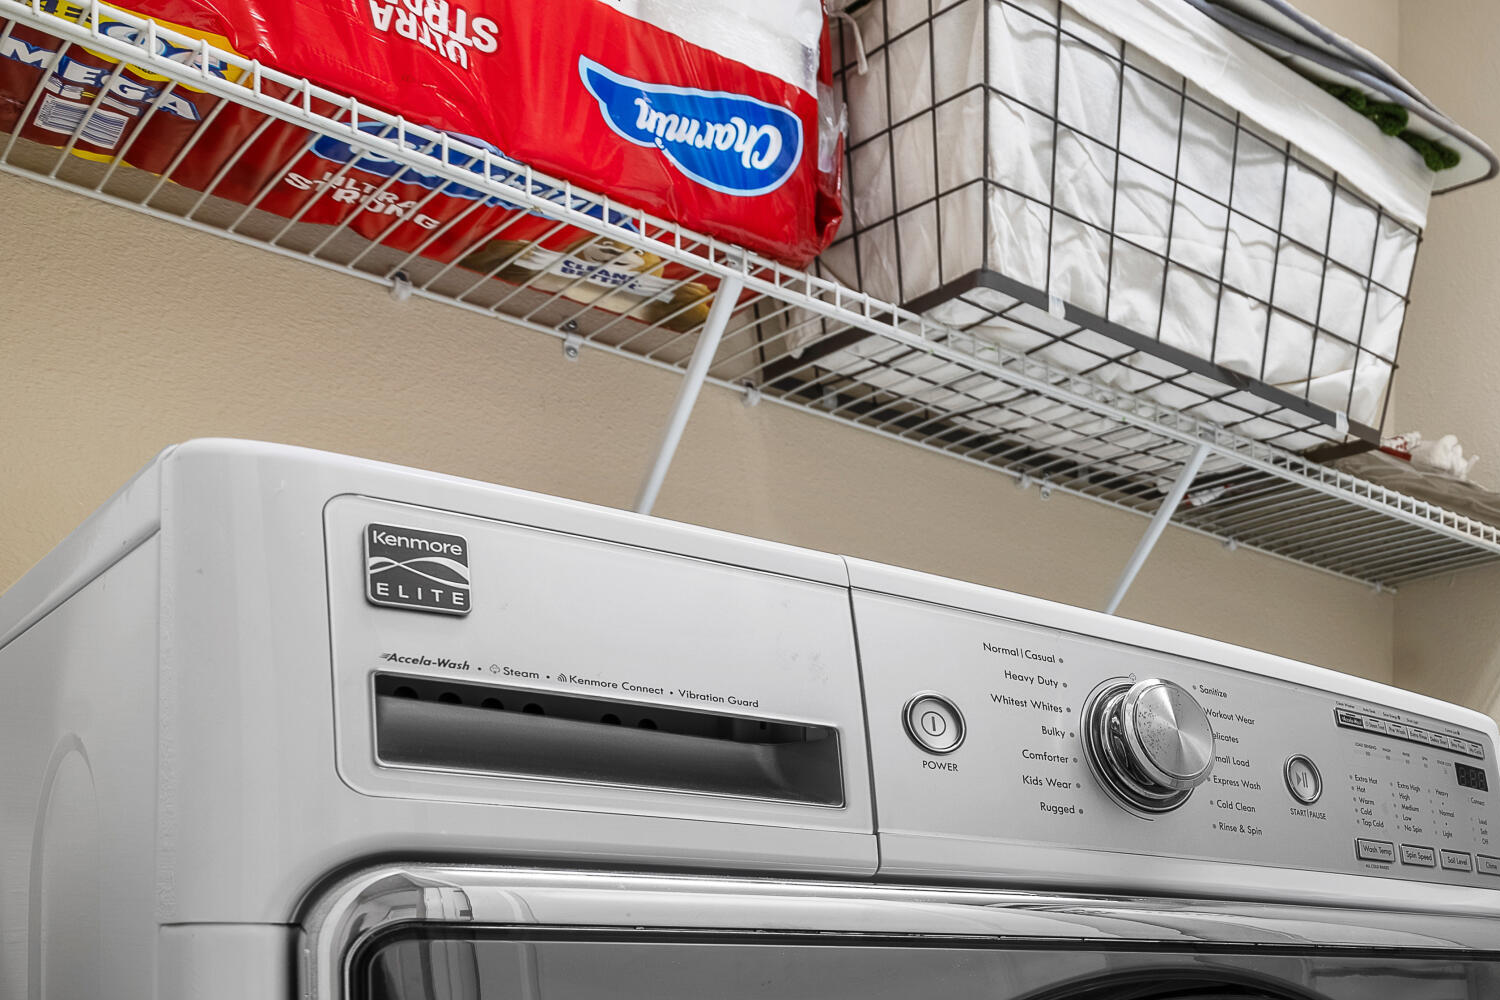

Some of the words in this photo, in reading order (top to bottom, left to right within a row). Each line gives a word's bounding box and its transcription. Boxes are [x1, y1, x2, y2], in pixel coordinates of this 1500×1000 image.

[390, 0, 498, 53] STR
[369, 0, 468, 69] ULTRA
[1, 36, 200, 121] MEGA
[634, 98, 784, 170] Charmin
[322, 171, 417, 210] ULTRA
[373, 530, 462, 555] Kenmore
[377, 582, 464, 605] ELITE
[388, 653, 470, 671] Accela-Wash
[503, 666, 540, 680] Steam
[569, 674, 618, 689] Kenmore
[621, 681, 664, 695] Connect
[678, 688, 725, 703] Vibration
[727, 696, 759, 708] Guard
[1004, 670, 1034, 685] Heavy
[1037, 676, 1058, 688] Duty
[1199, 685, 1227, 698] Sanitize
[990, 693, 1027, 708] Whitest
[1030, 700, 1063, 713] Whites
[1203, 707, 1233, 721] Workout
[1235, 714, 1255, 725] Wear
[1041, 726, 1066, 739] Bulky
[1212, 732, 1239, 744] elicates
[1022, 750, 1069, 763] Comforter
[1215, 755, 1231, 765] mall
[1232, 757, 1250, 768] Load
[922, 760, 959, 772] POWER
[1022, 775, 1043, 786] Kids
[1046, 778, 1072, 789] Wear
[1213, 775, 1240, 788] Express
[1241, 779, 1261, 791] Wash
[1355, 774, 1368, 783] Extra
[1356, 785, 1366, 793] Hot
[1397, 781, 1409, 790] Extra
[1359, 797, 1375, 805] Warm
[1399, 792, 1410, 801] High
[1040, 802, 1075, 815] Rugged
[1216, 800, 1233, 810] Cold
[1235, 802, 1256, 813] Clean
[1360, 807, 1372, 815] Cold
[1401, 804, 1419, 812] Medium
[1219, 822, 1237, 833] Rinse
[1239, 825, 1246, 834] &
[1247, 827, 1263, 836] Spin
[1373, 820, 1384, 828] Cold
[1363, 845, 1378, 854] Wash
[1378, 847, 1392, 857] Temp
[1406, 850, 1417, 859] Spin
[1418, 853, 1432, 862] Speed
[1447, 856, 1456, 864] Soil
[1457, 858, 1468, 866] Level
